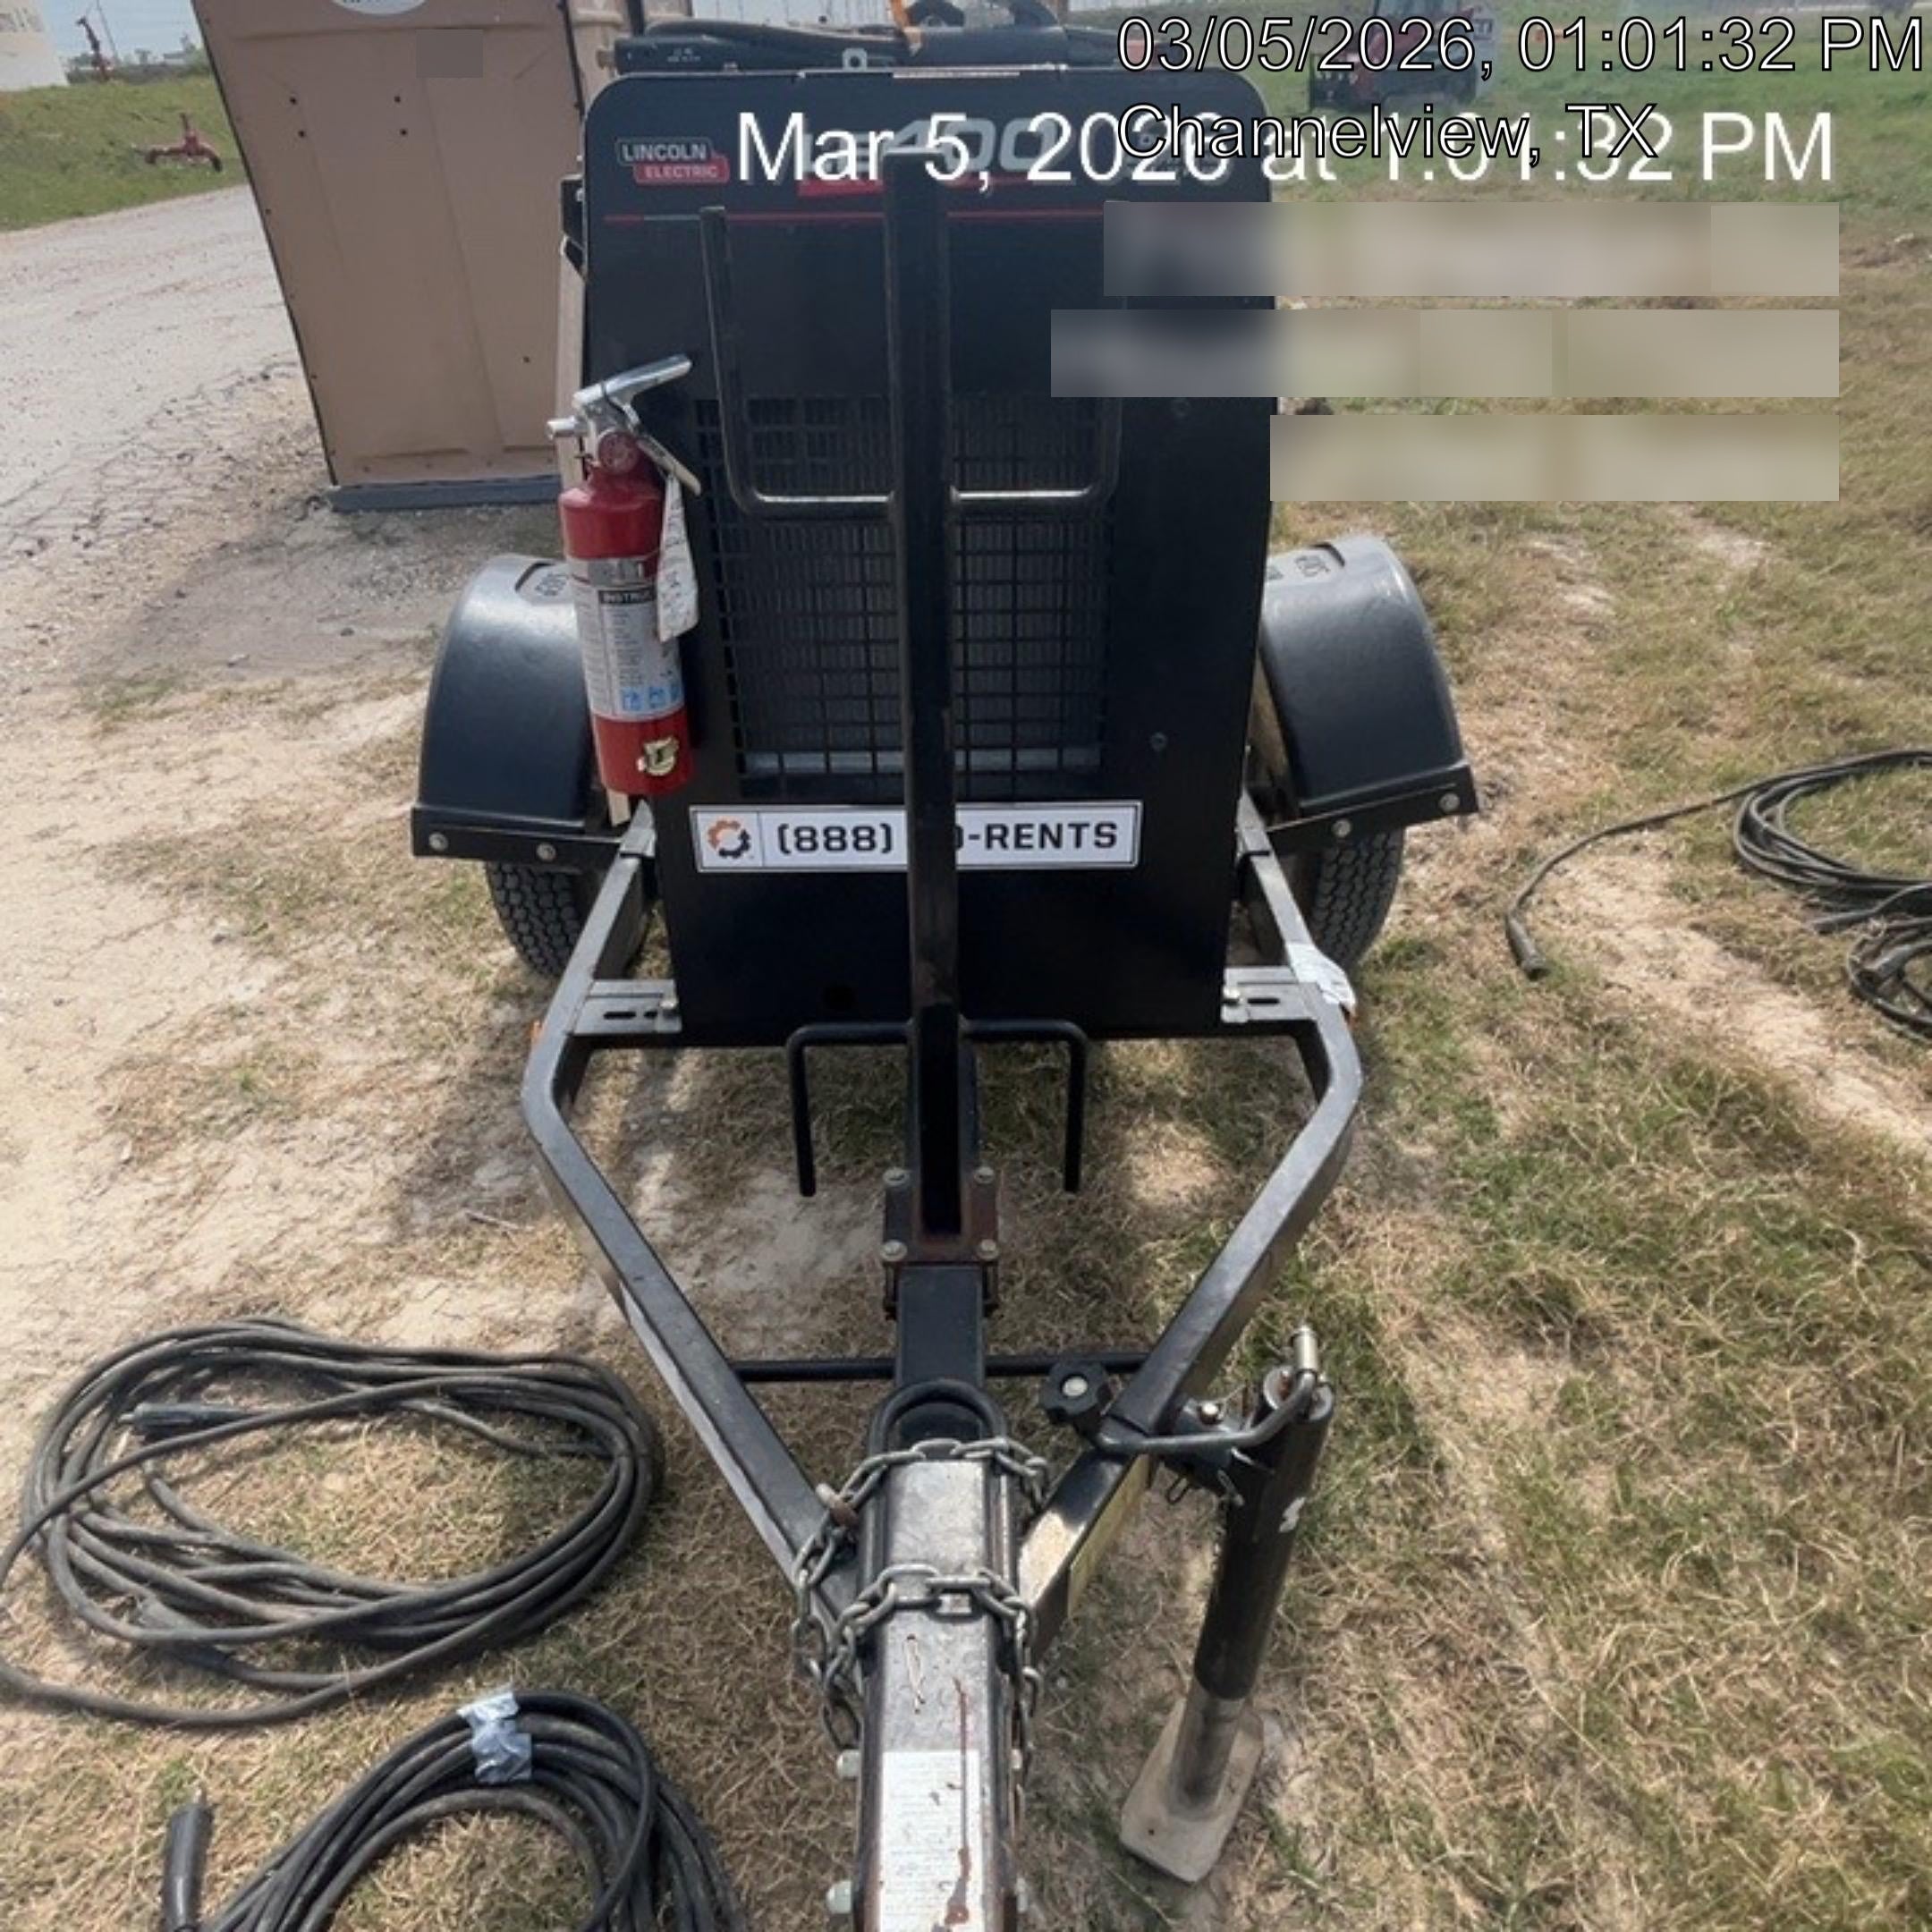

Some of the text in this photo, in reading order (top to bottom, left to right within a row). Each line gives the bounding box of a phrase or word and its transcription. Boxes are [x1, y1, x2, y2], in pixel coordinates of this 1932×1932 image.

[621, 142, 707, 161] LINCOLN
[643, 165, 719, 179] ELECTRIC
[777, 823, 893, 854] (888)
